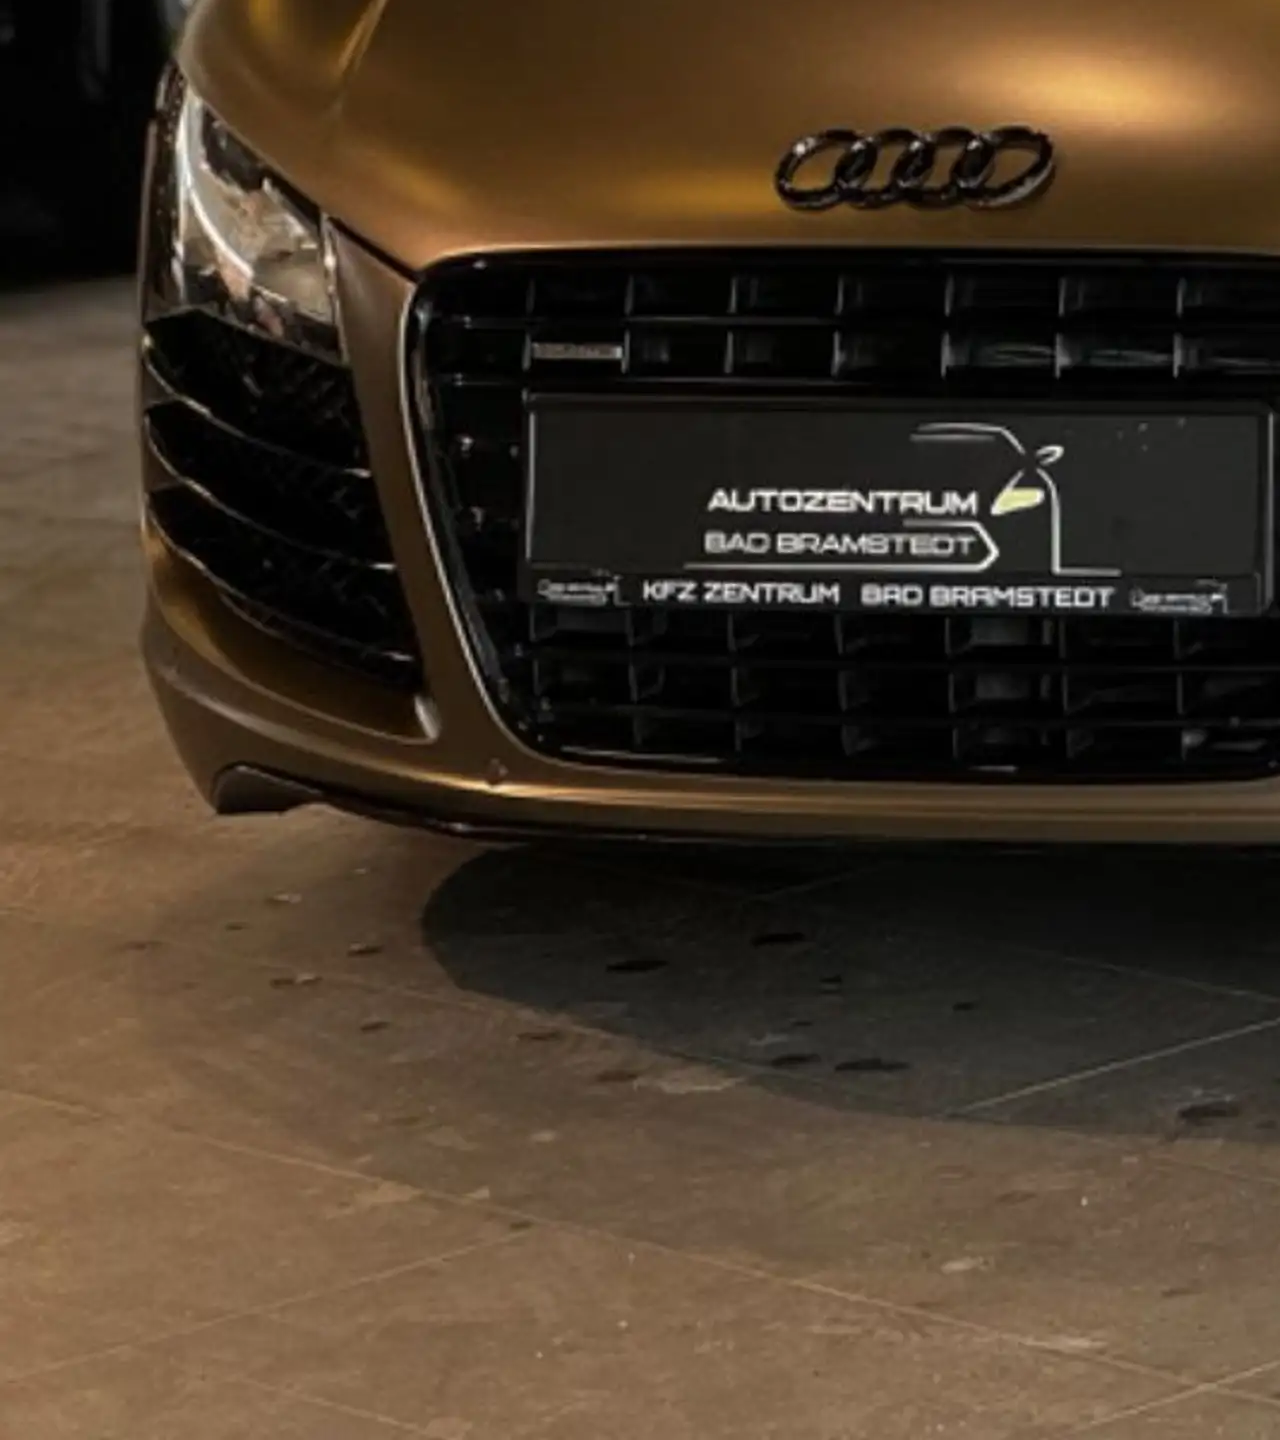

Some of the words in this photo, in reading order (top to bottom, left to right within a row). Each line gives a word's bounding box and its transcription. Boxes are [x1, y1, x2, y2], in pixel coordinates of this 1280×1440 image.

[707, 488, 978, 514] AUTOZENTRUM
[704, 530, 770, 554] BAD
[776, 532, 976, 556] BRAMSTEDT
[643, 580, 698, 601] KFZ
[703, 580, 840, 604] ZENTRUM
[860, 583, 923, 606] BAD
[929, 584, 1116, 608] BRAMSTEDT
